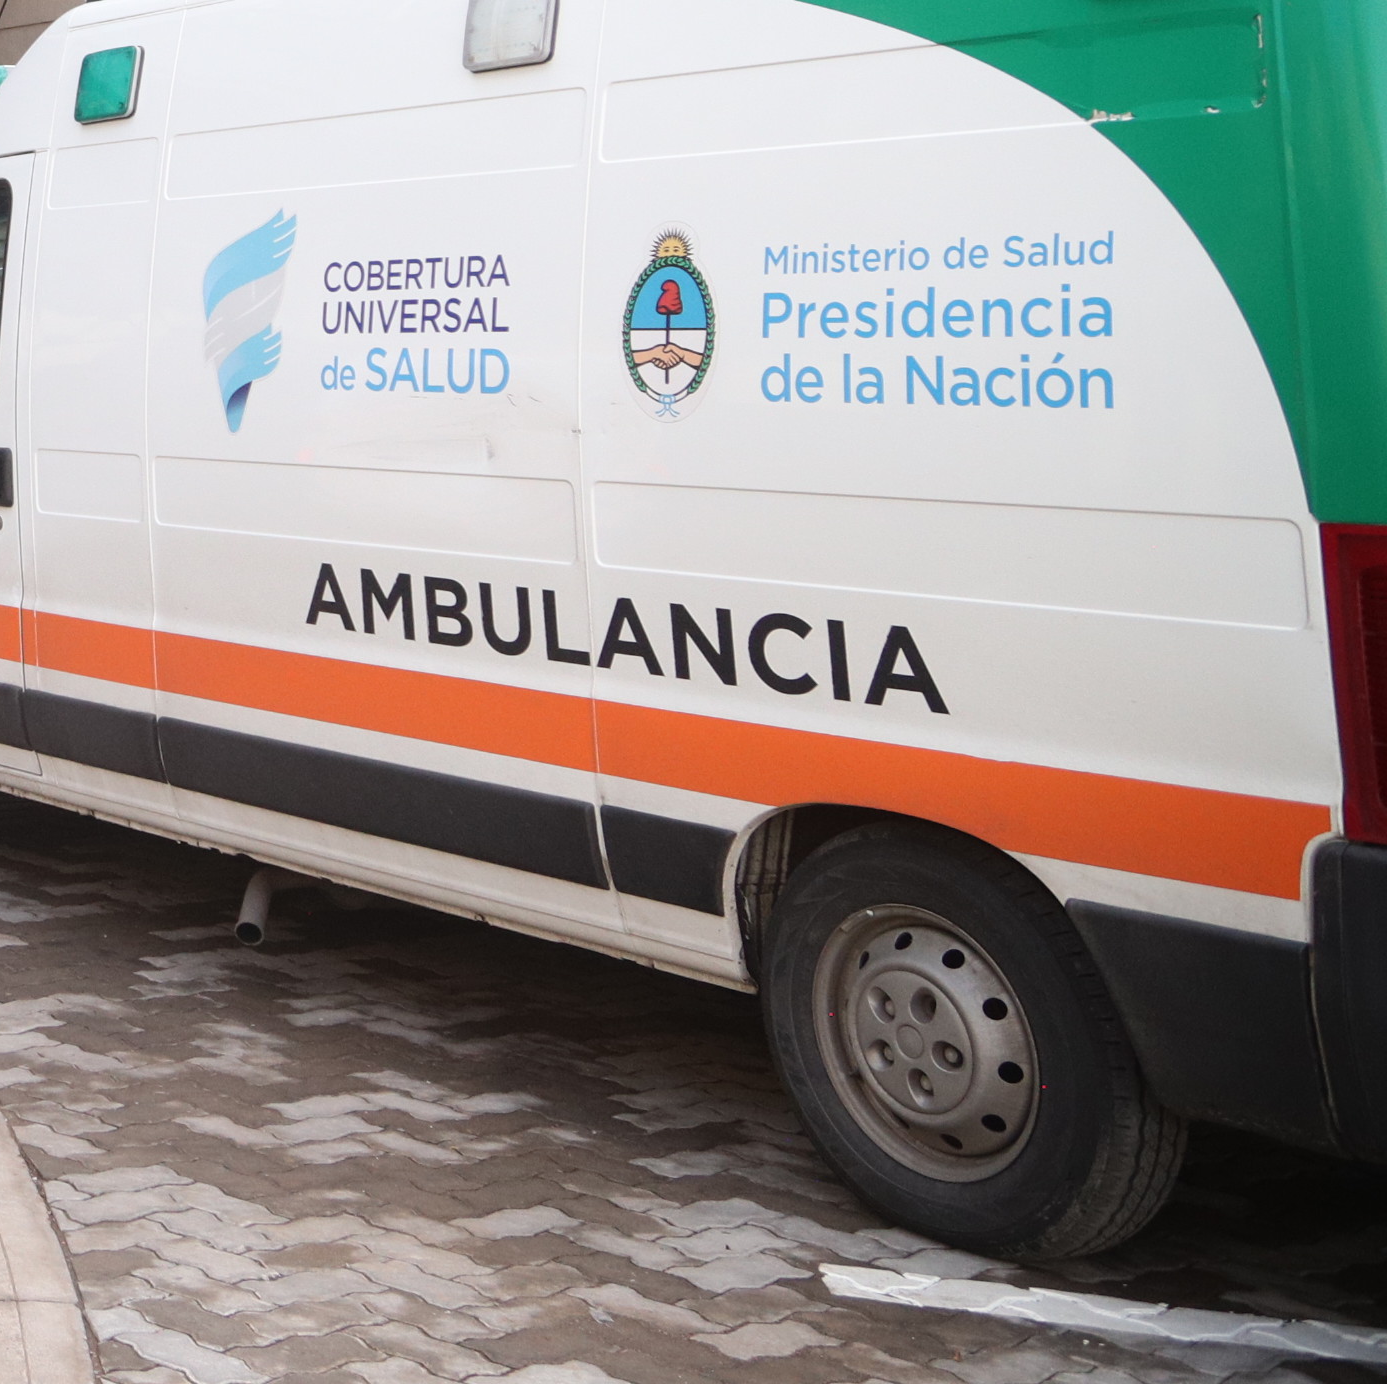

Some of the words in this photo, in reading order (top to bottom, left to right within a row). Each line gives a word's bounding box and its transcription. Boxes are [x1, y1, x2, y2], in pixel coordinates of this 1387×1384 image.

[323, 254, 511, 293] COBERTURA
[763, 240, 931, 276] Ministerio
[943, 236, 990, 270] de
[1003, 230, 1115, 269] Salud
[322, 296, 510, 335] UNIVERSAL
[762, 283, 1114, 339] Presidencia
[320, 355, 357, 391] de
[364, 347, 511, 394] SALUD
[760, 352, 825, 404] de
[842, 352, 885, 405] la
[905, 351, 1115, 410] Nación
[305, 562, 951, 716] AMBULANCIA
